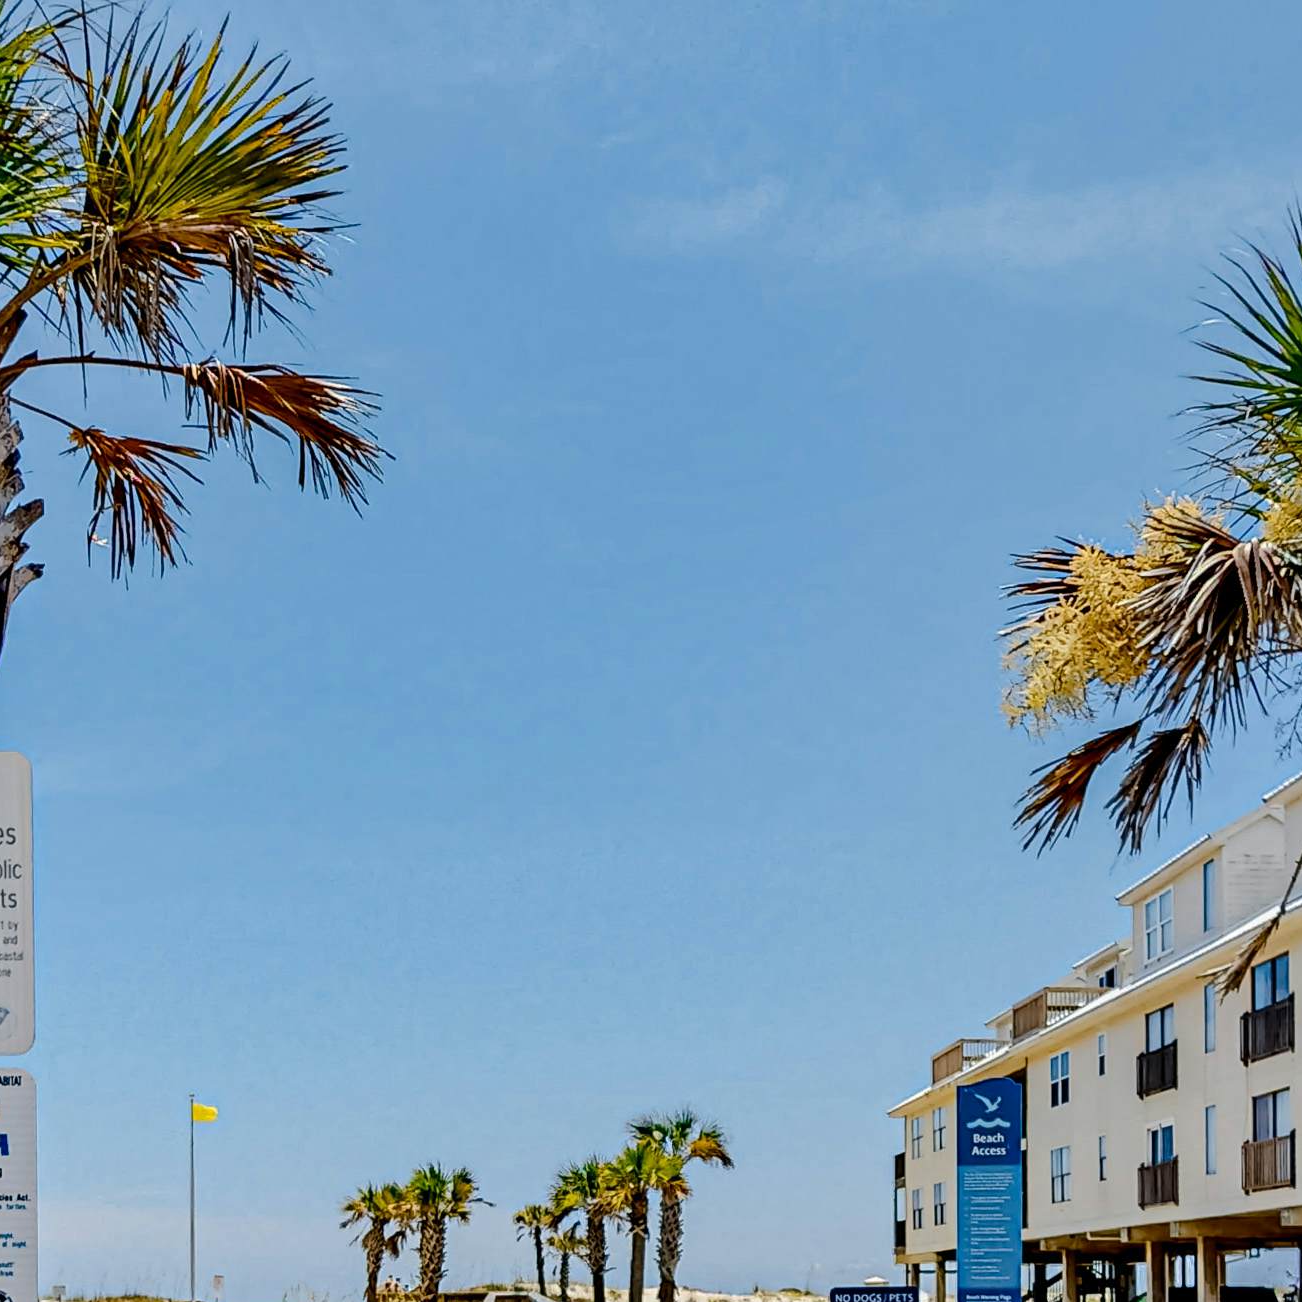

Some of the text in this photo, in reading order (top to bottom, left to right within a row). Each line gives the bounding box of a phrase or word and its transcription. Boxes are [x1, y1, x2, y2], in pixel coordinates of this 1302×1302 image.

[8, 920, 18, 931] by
[3, 935, 18, 944] and
[973, 1133, 1005, 1144] Beach
[971, 1146, 1007, 1156] Access
[835, 1293, 850, 1302] NO
[853, 1293, 882, 1302] DOGS
[889, 1293, 914, 1302] PETS
